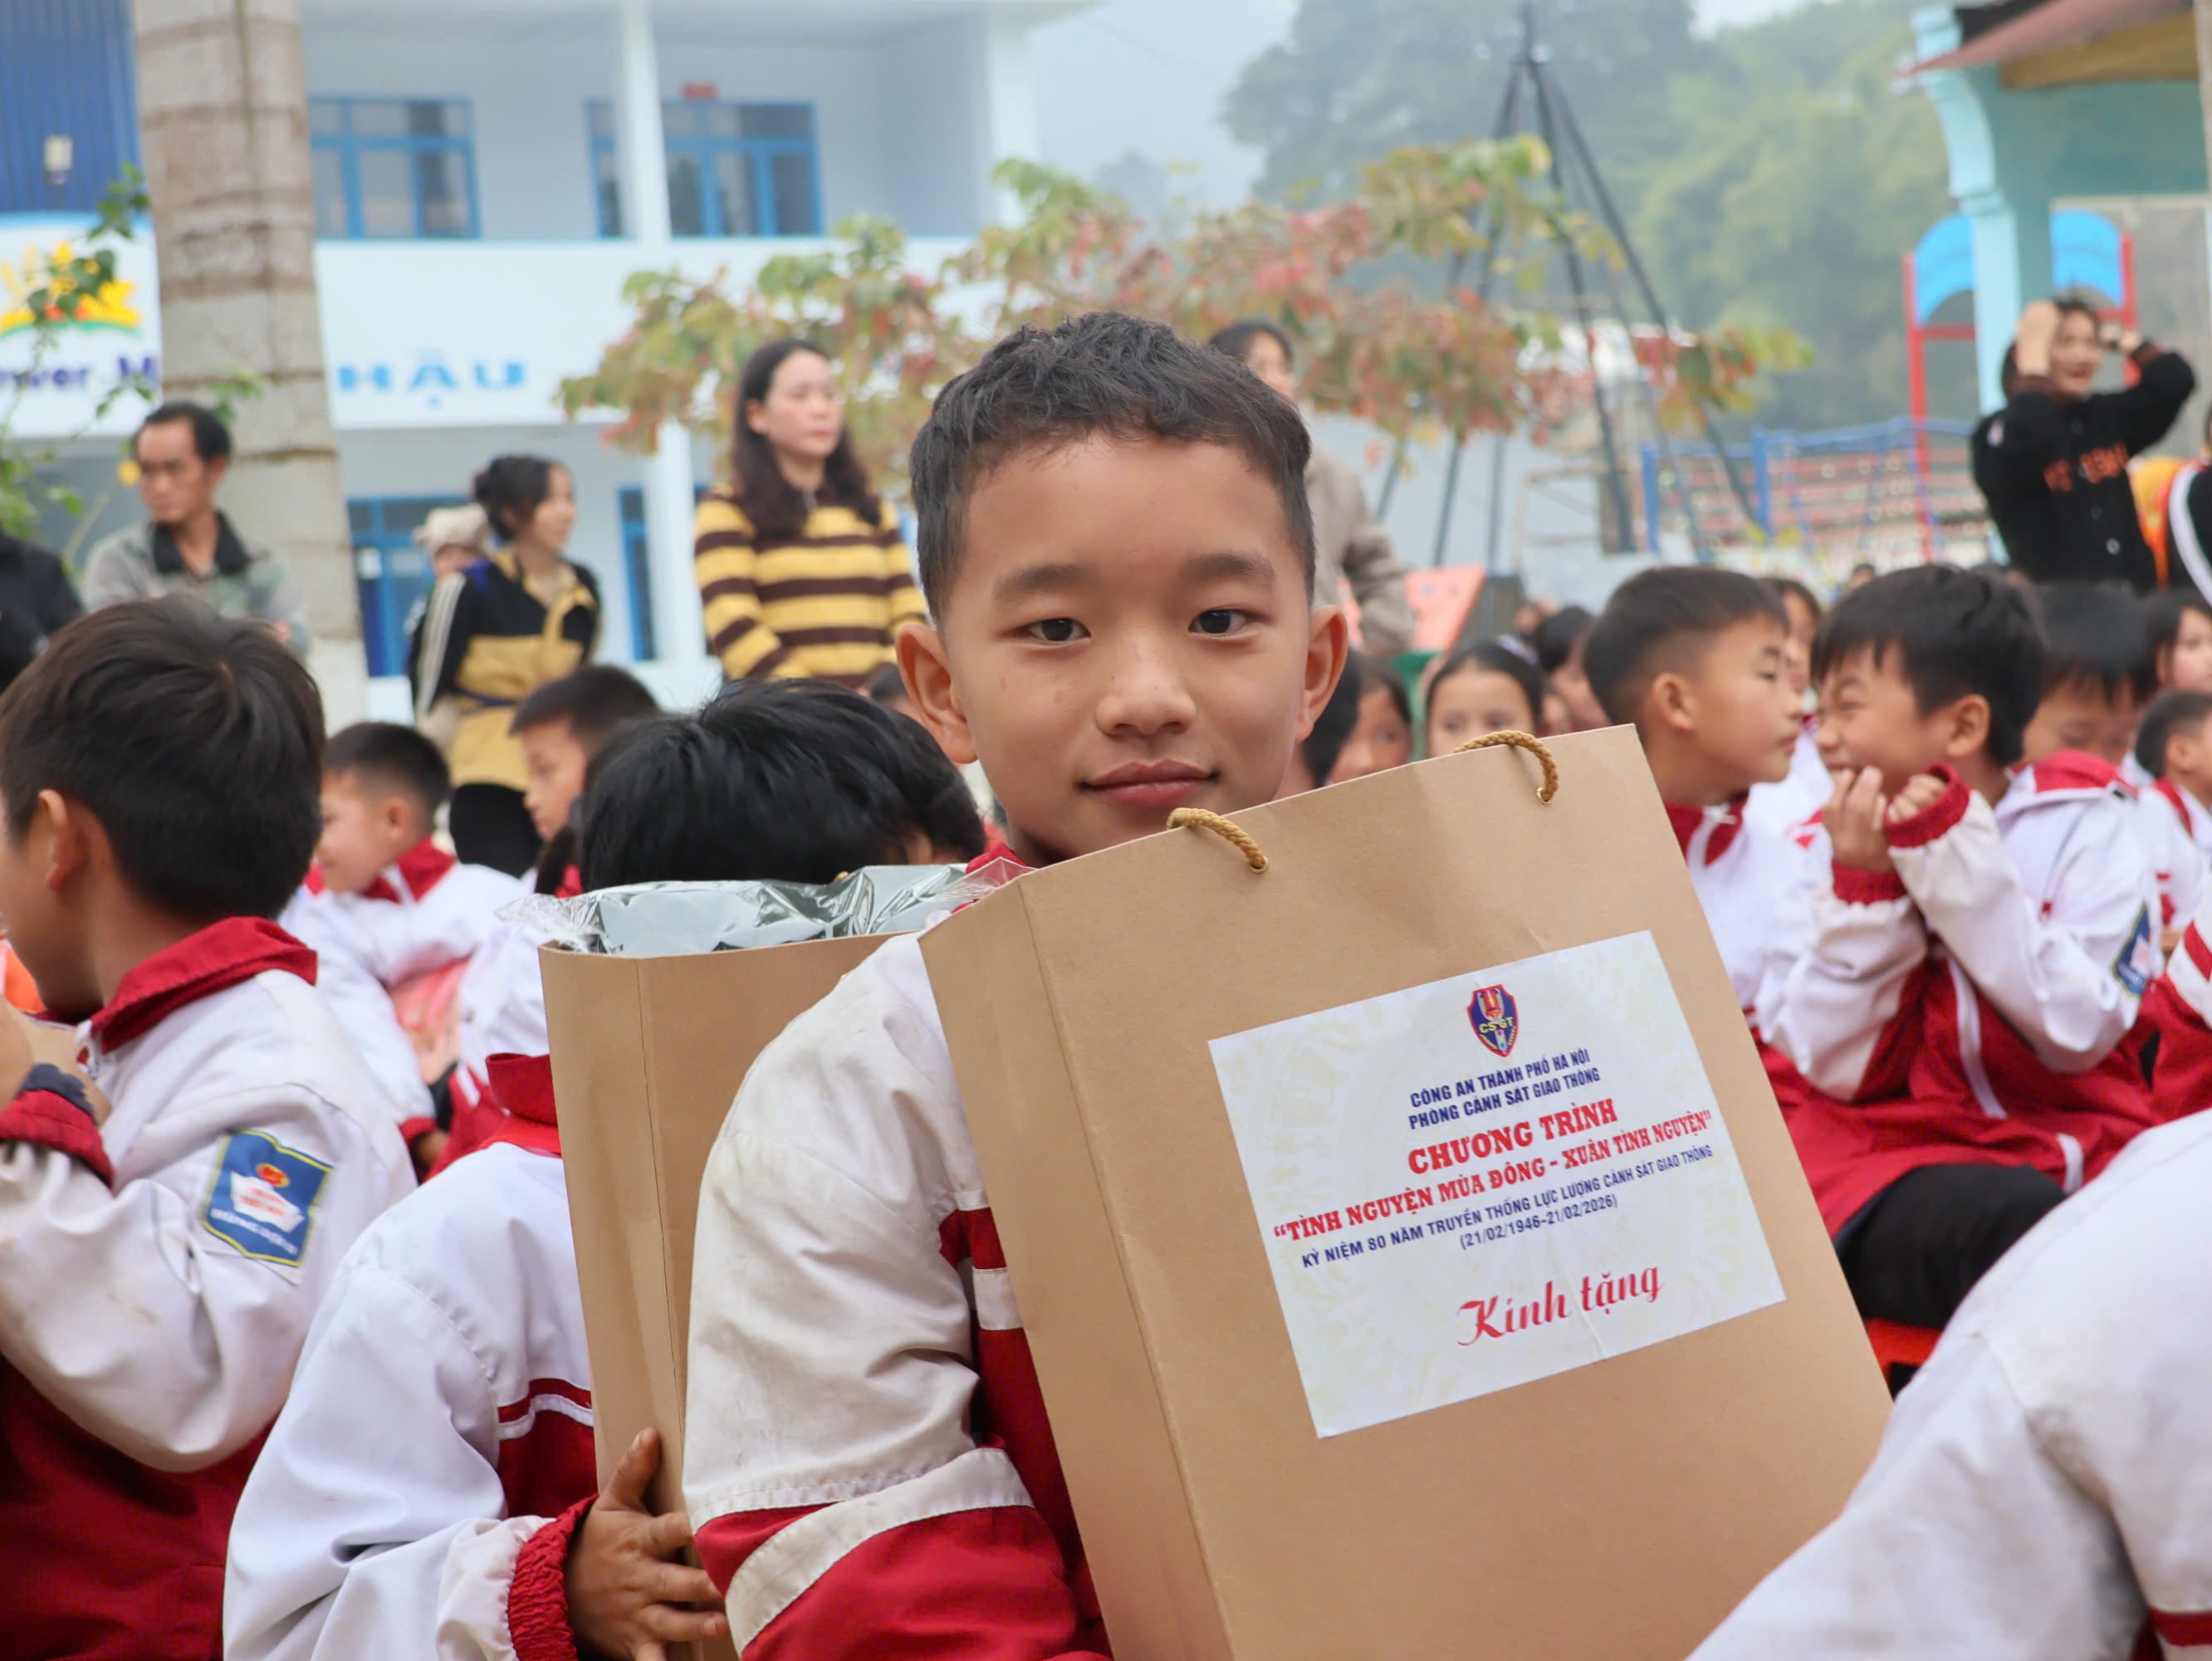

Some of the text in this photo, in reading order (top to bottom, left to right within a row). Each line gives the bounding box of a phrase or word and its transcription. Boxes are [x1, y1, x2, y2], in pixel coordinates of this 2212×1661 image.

[1409, 1067, 1600, 1129] PHÒNG CẢNH SÁT GIAO THÔNG
[1410, 1048, 1590, 1107] CÔNG AN THÀNH PHỐ HÀ NỘI
[1408, 1098, 1618, 1173] CHƯƠNG TRÌNH
[1325, 1241, 1364, 1262] NIỆM
[1368, 1235, 1387, 1250] 80
[1390, 1225, 1424, 1245] NĂM
[1427, 1208, 1483, 1235] TRUYỀN
[1485, 1196, 1531, 1220] THỐNG
[1534, 1189, 1559, 1208] LỰC
[1561, 1178, 1601, 1200] LƯỢNG
[1603, 1169, 1634, 1188] CẢNH
[1636, 1160, 1654, 1178] SÁT
[1657, 1154, 1680, 1172] GIAO
[1681, 1144, 1713, 1164] THÔNG
[1346, 1186, 1434, 1225] NGUYỆN
[1437, 1174, 1485, 1203] MÙA
[1489, 1158, 1546, 1189] ĐÔNG
[1562, 1139, 1612, 1169] XUÂN
[1613, 1129, 1652, 1154] TÌNH
[1456, 1267, 1665, 1346] Kính tặng
